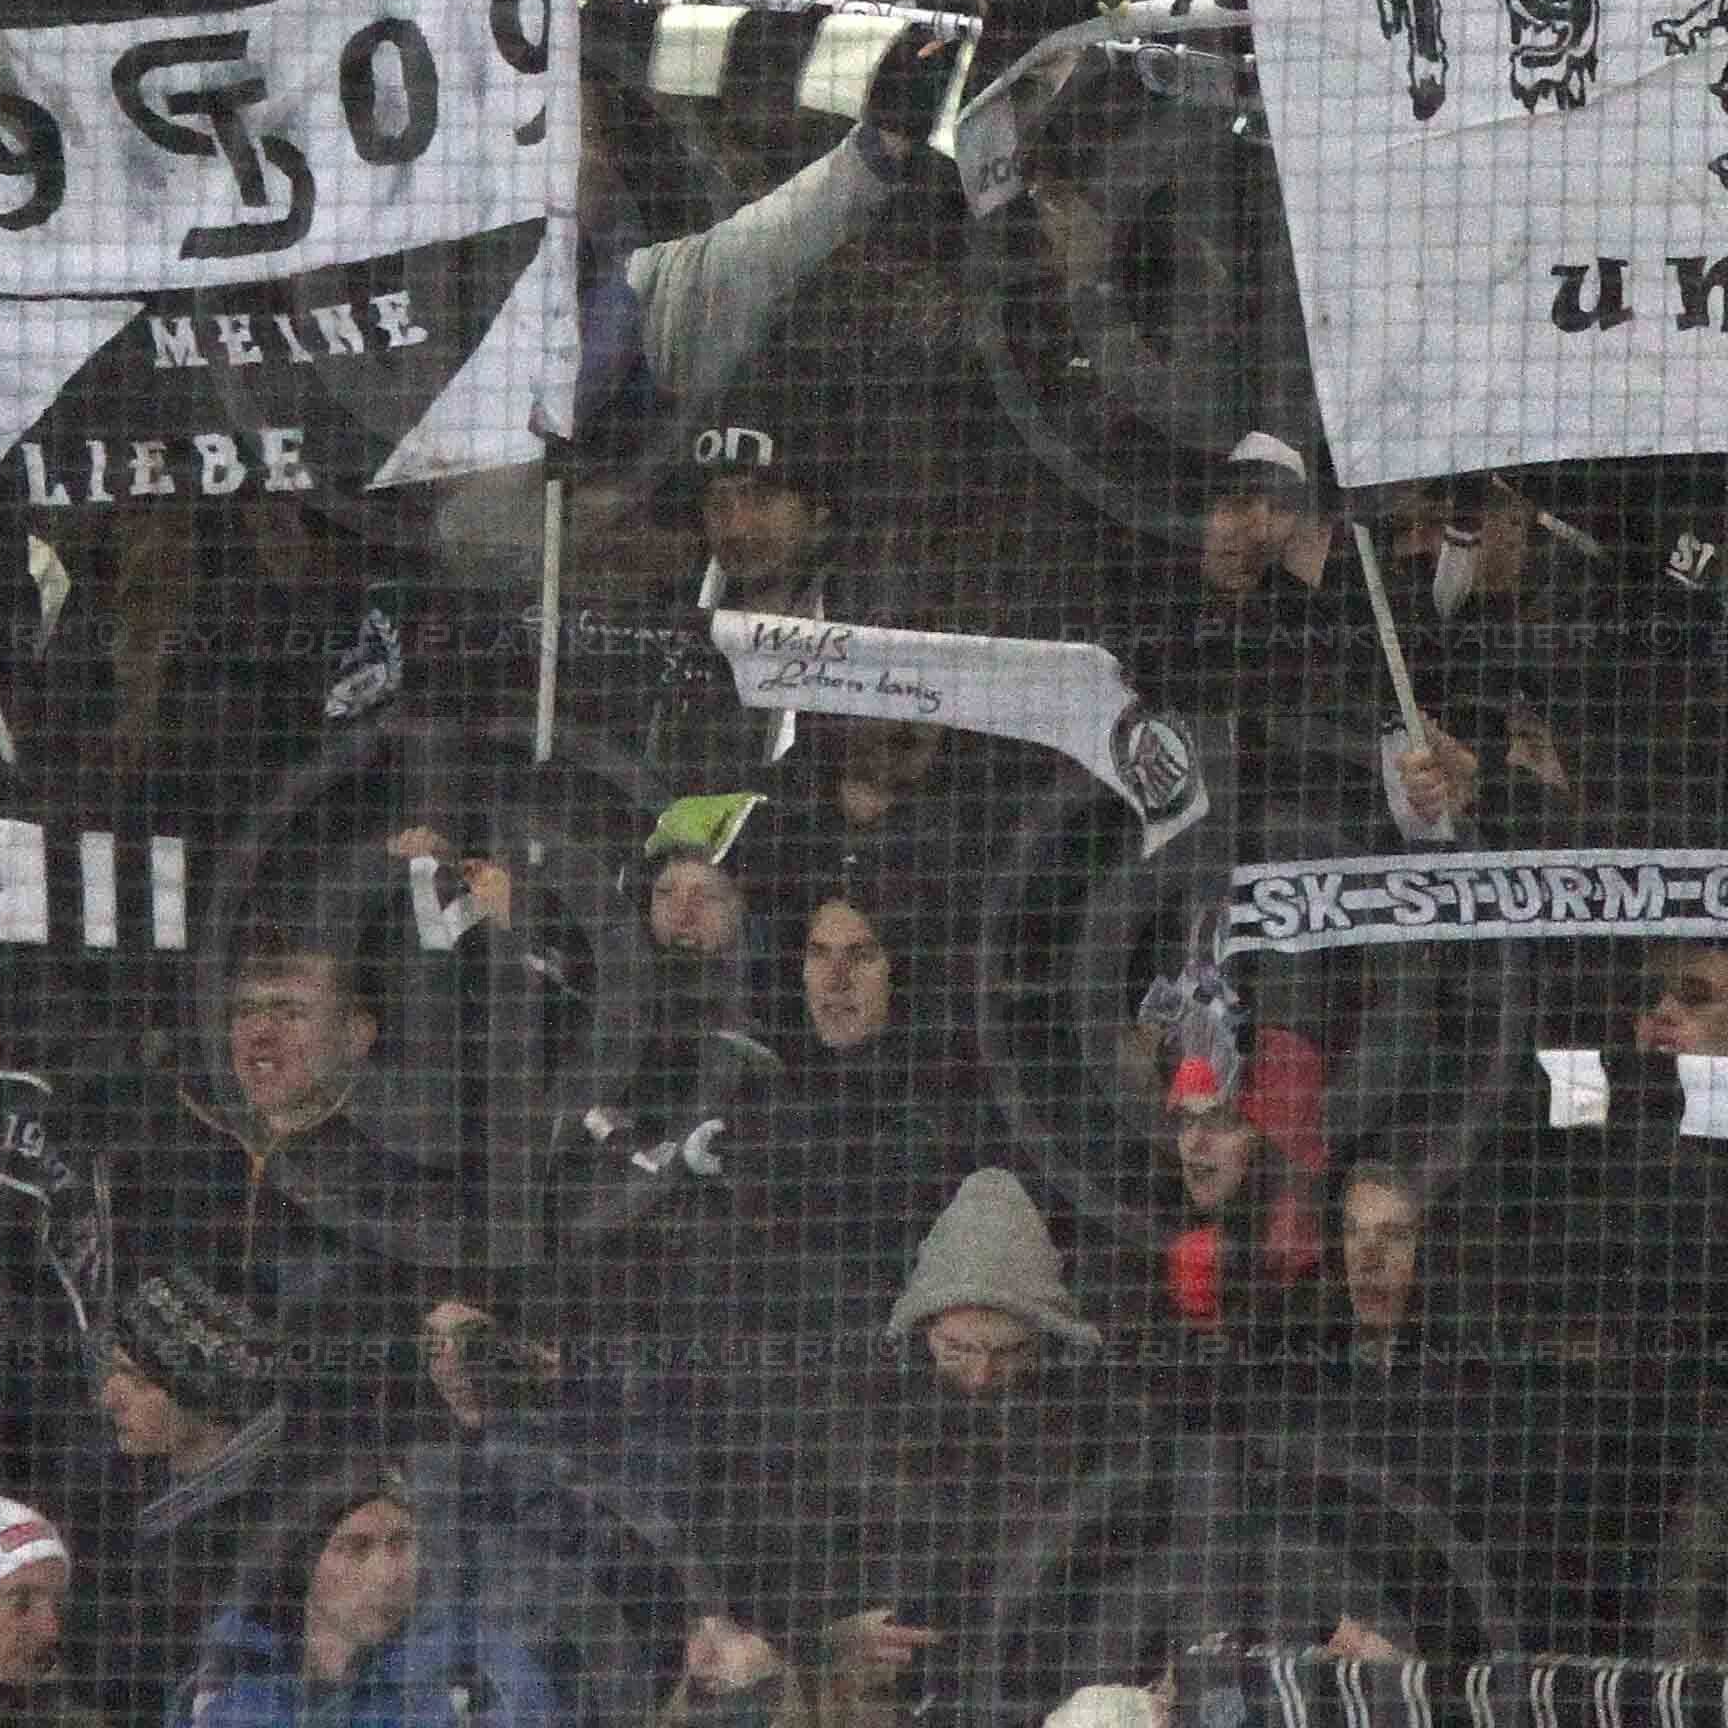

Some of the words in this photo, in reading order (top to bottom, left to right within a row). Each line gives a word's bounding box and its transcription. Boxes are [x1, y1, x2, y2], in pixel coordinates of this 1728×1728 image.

[147, 289, 429, 370] MEINE
[18, 428, 314, 509] LIEBE
[1253, 871, 1352, 941] SK
[1384, 866, 1667, 925] STURM
